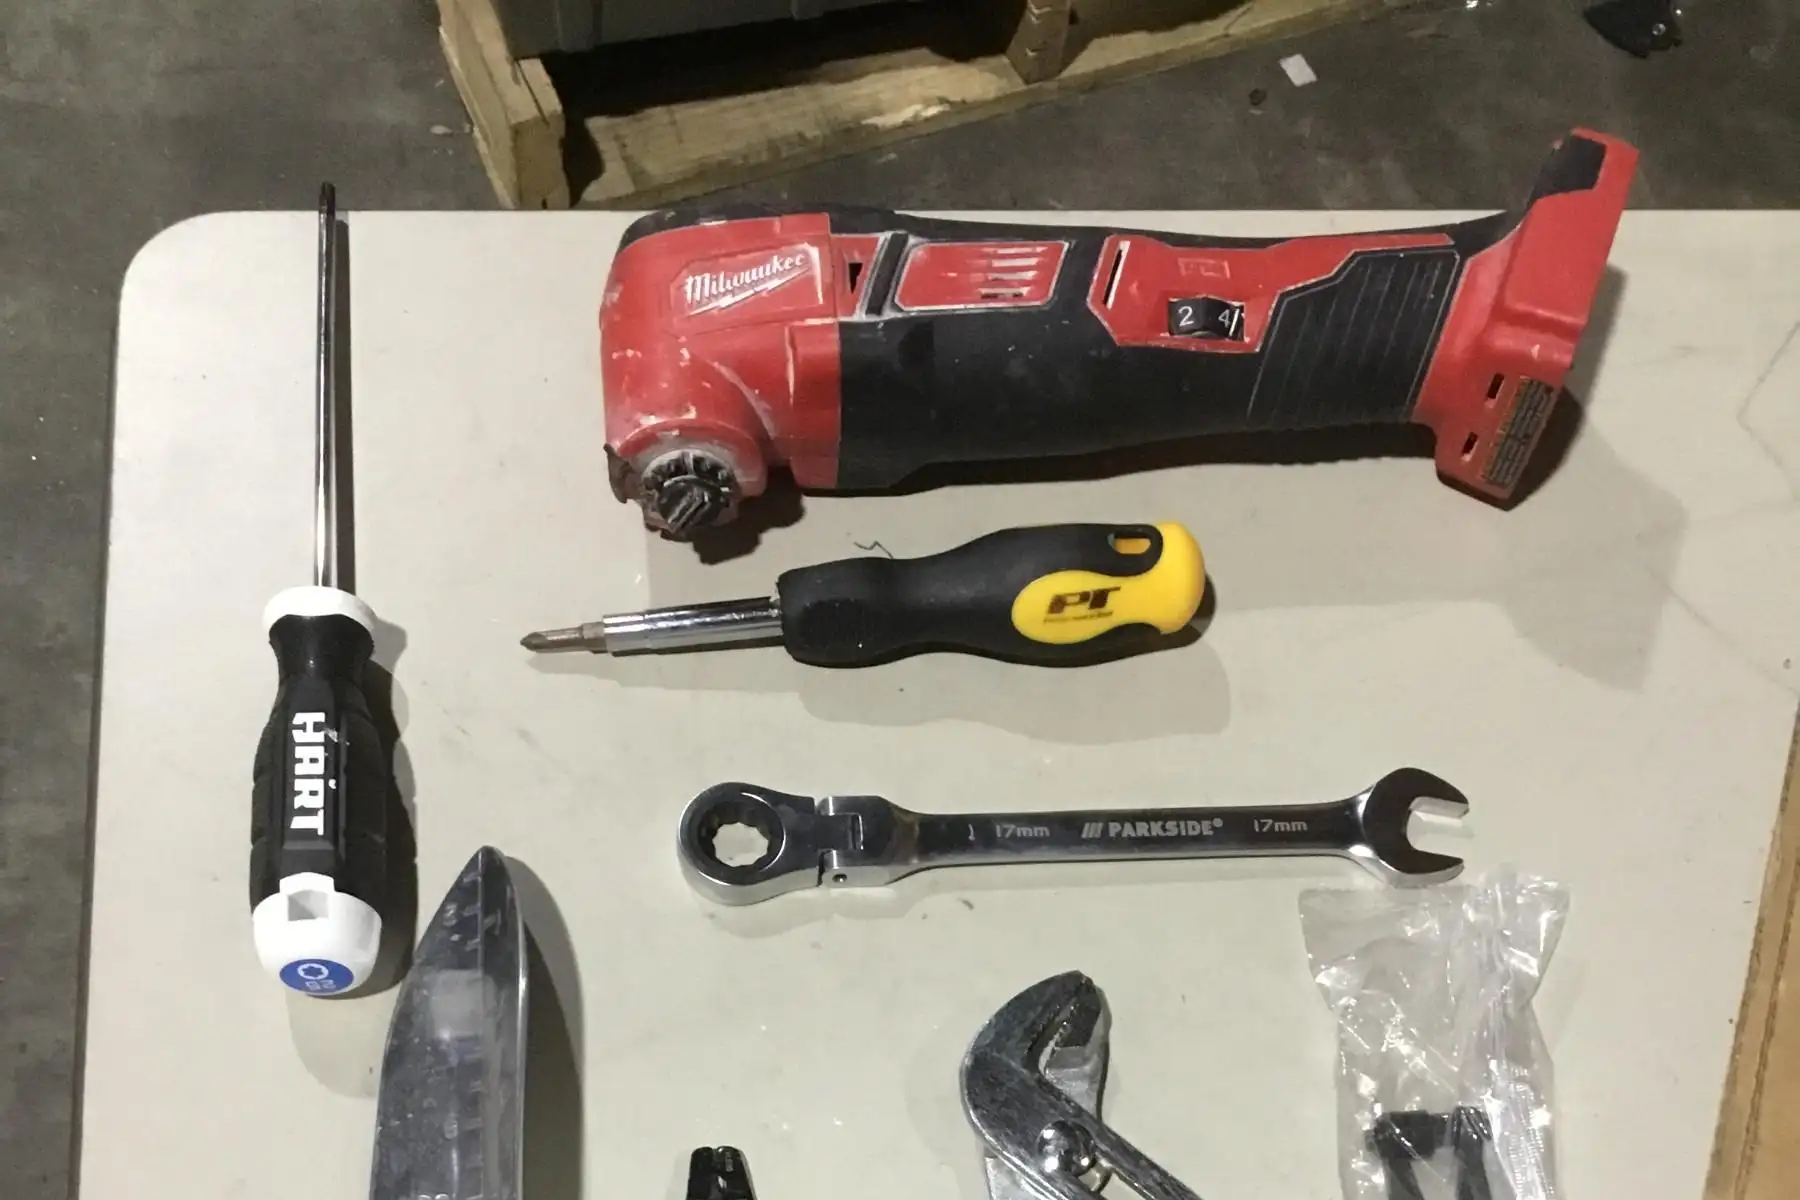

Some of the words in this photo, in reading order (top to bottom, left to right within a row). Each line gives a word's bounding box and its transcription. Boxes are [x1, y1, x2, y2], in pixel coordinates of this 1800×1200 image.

[684, 252, 806, 304] Milwaukee
[1178, 305, 1195, 328] 2
[1217, 308, 1231, 329] 4
[290, 711, 326, 836] HART
[995, 823, 1050, 839] 17mm
[1253, 818, 1309, 833] 17mm
